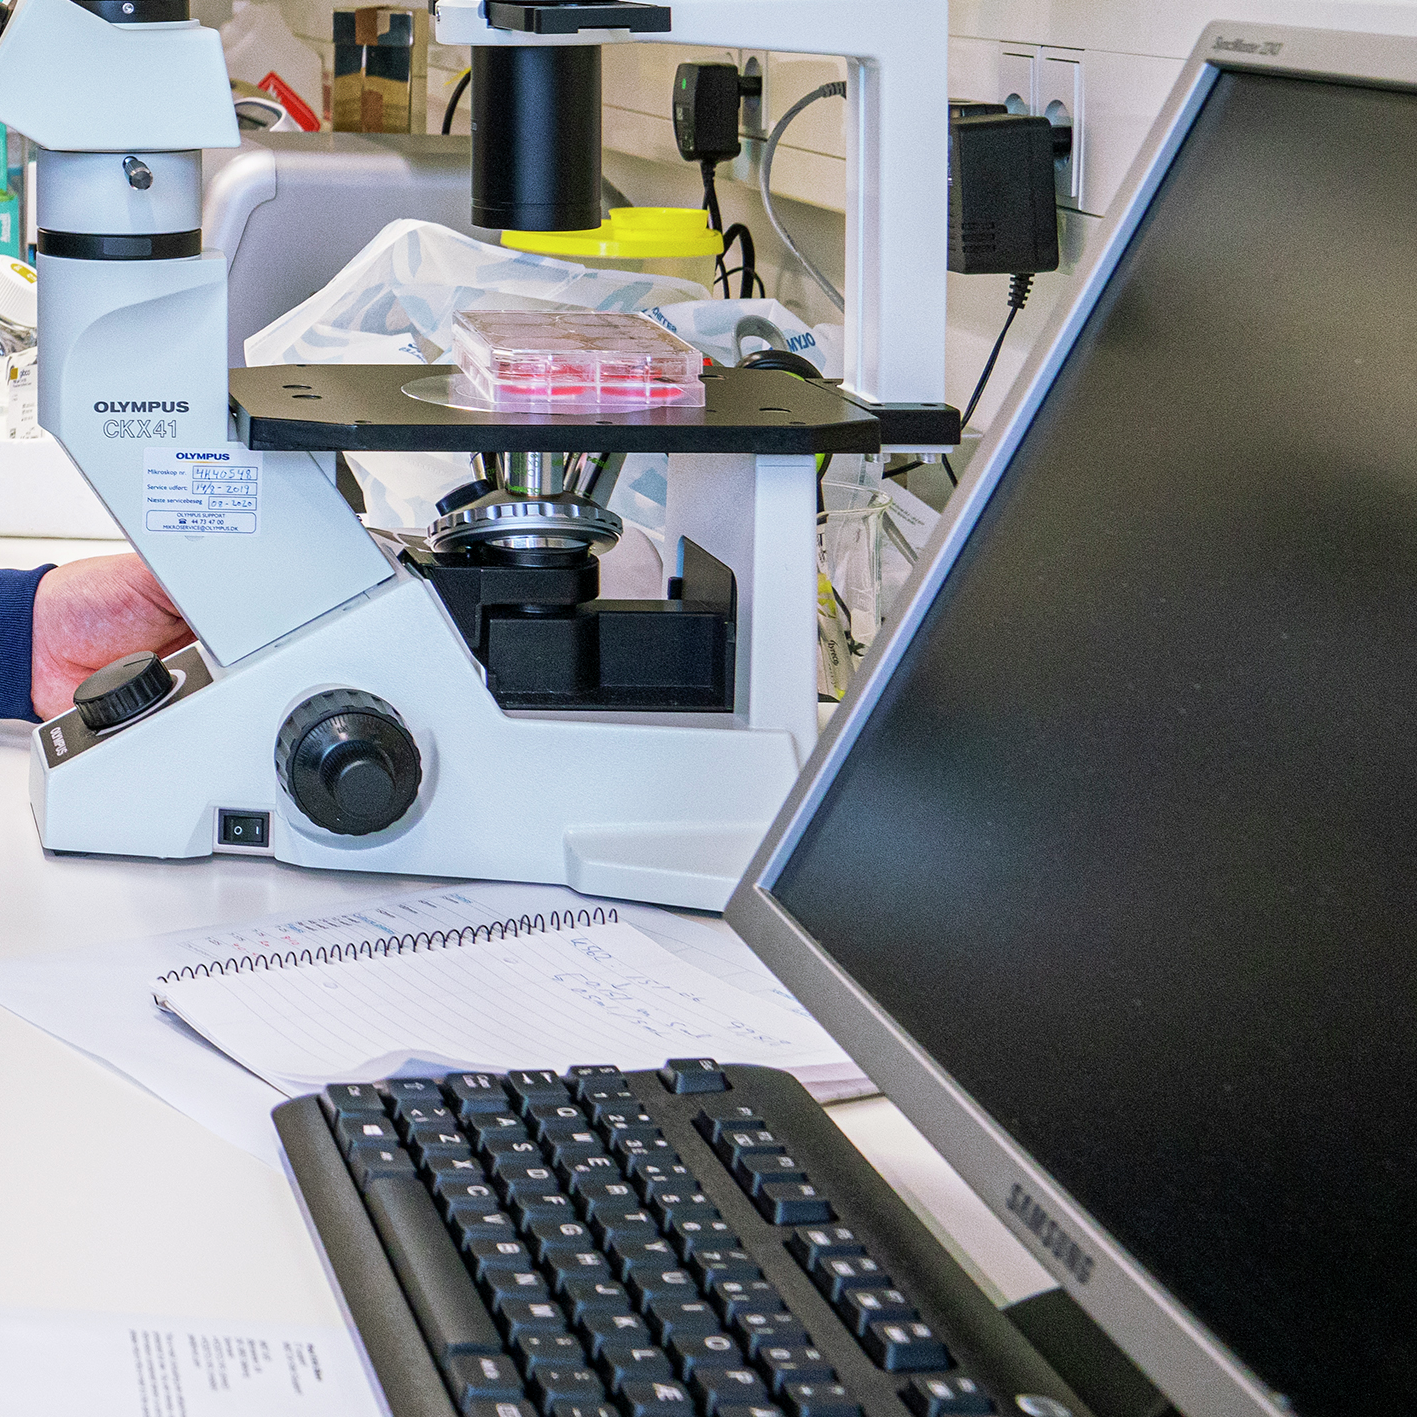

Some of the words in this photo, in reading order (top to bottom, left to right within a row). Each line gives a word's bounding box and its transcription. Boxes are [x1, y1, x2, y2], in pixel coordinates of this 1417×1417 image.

[93, 401, 190, 413] OLYMPUS
[103, 419, 177, 439] CKX41
[175, 452, 230, 461] OLYMPUS
[147, 469, 177, 477] Mikroskop
[226, 485, 250, 495] 2019
[439, 1133, 462, 1143] Z
[452, 1159, 475, 1170] X
[467, 1185, 490, 1197] C
[482, 1213, 506, 1225] V
[496, 1117, 517, 1127] A
[512, 1142, 534, 1152] S
[526, 1168, 550, 1179] D
[542, 1195, 566, 1206] F
[560, 1223, 584, 1236] G
[575, 1253, 601, 1266] H
[595, 1284, 620, 1295] J
[612, 1316, 639, 1329] K
[631, 1349, 658, 1361] L
[1006, 1182, 1095, 1285] SAMSUNG
[587, 1157, 611, 1167] E
[625, 1213, 648, 1223] T
[644, 1241, 668, 1252] Y
[704, 1335, 731, 1351] O
[725, 1370, 754, 1384] P
